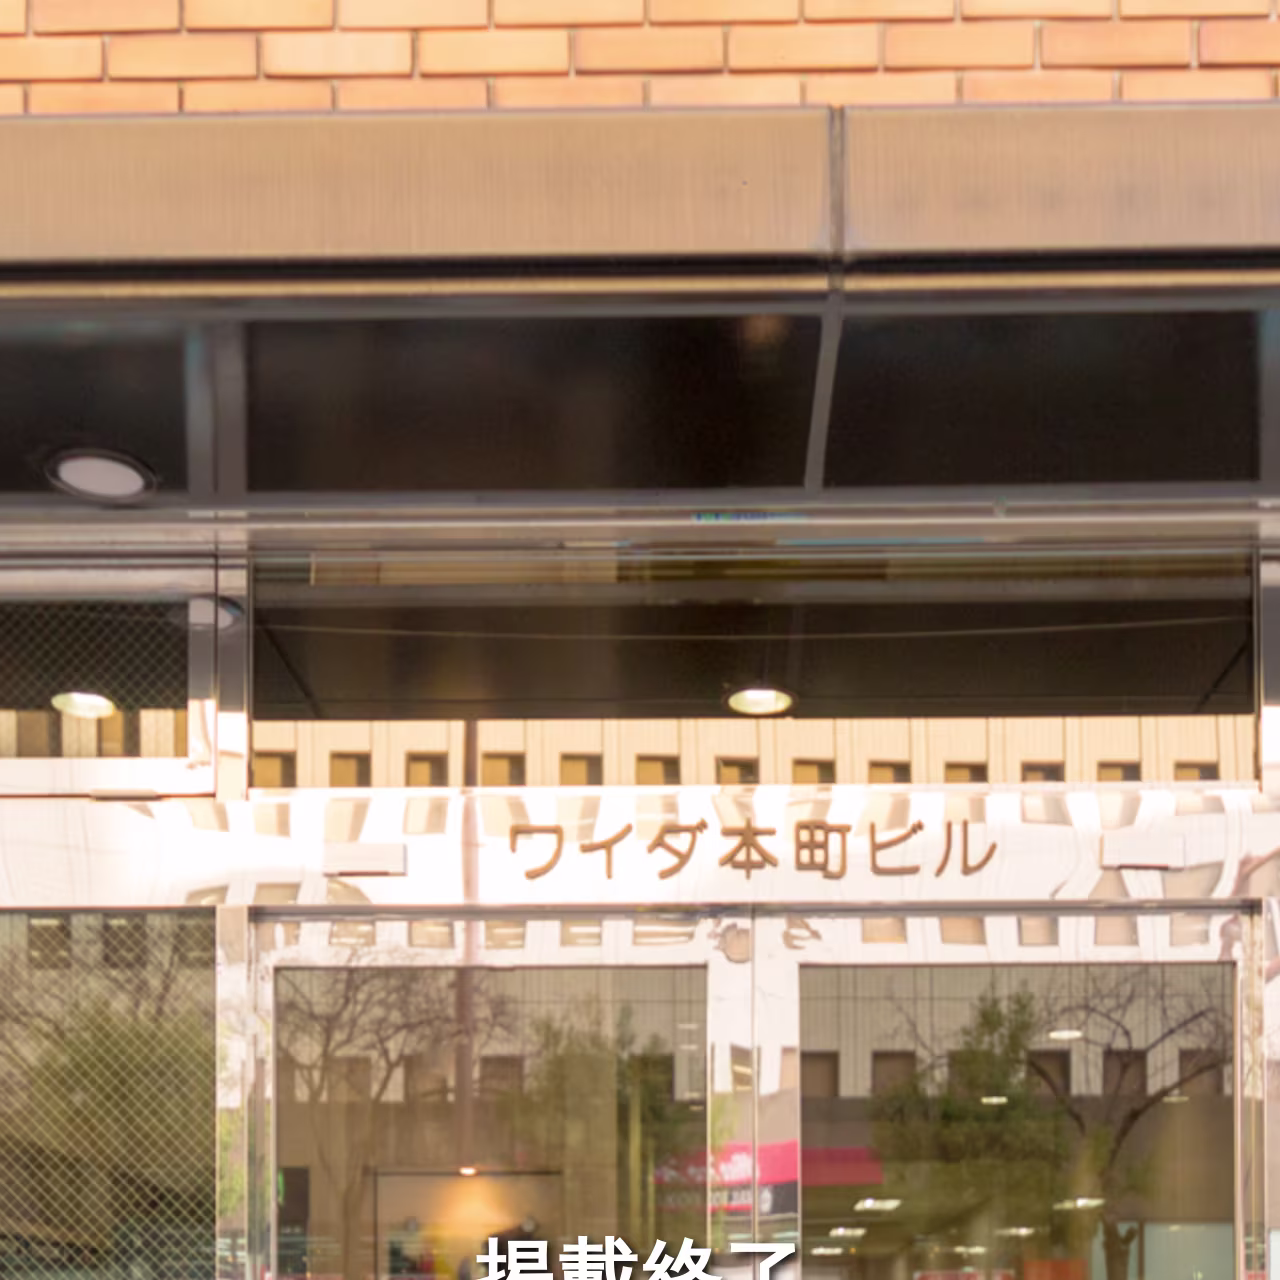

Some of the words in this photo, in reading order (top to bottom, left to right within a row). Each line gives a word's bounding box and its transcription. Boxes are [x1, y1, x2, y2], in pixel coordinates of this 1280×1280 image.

[509, 817, 997, 880] ワイダ本町ビル
